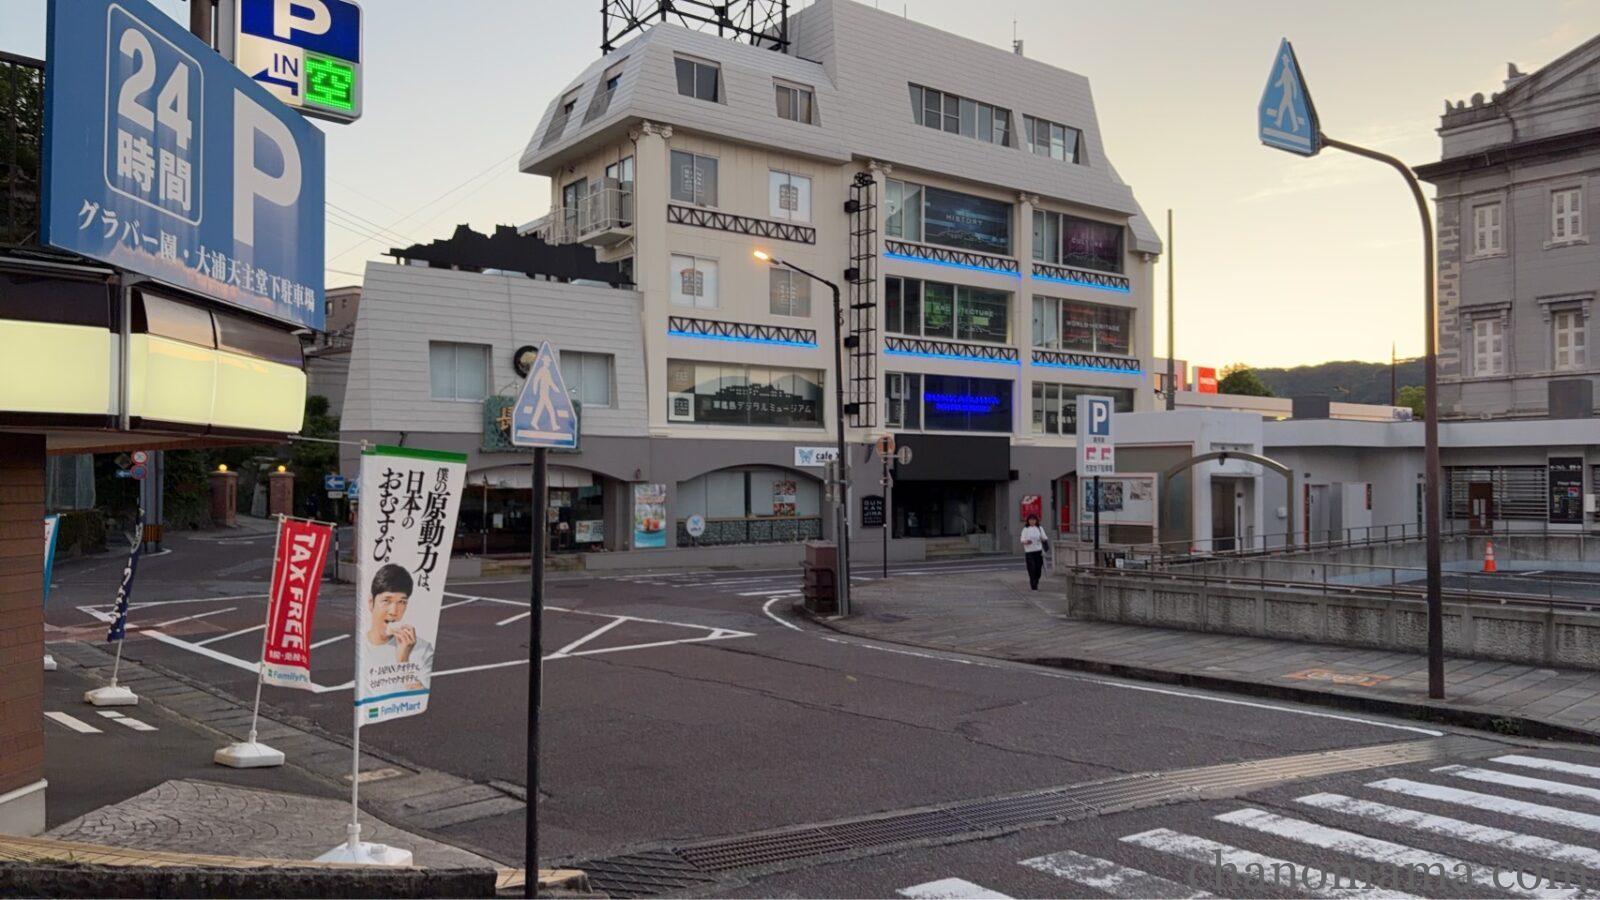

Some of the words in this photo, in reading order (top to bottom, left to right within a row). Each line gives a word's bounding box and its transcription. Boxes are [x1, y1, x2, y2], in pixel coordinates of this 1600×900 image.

[274, 0, 332, 40] P
[118, 27, 193, 150] 24
[274, 53, 298, 77] IN
[306, 59, 352, 110] 空
[117, 128, 192, 212] 時間
[233, 87, 302, 248] P
[78, 199, 315, 313] グラバー園・大浦天主堂下駐車場
[1092, 402, 1107, 433] P
[815, 451, 833, 461] cafe
[373, 467, 404, 563] おむすび。
[401, 469, 424, 529] 日本の
[412, 467, 451, 591] 僕の原動力は、
[289, 532, 317, 583] TAX
[281, 586, 305, 649] FREE
